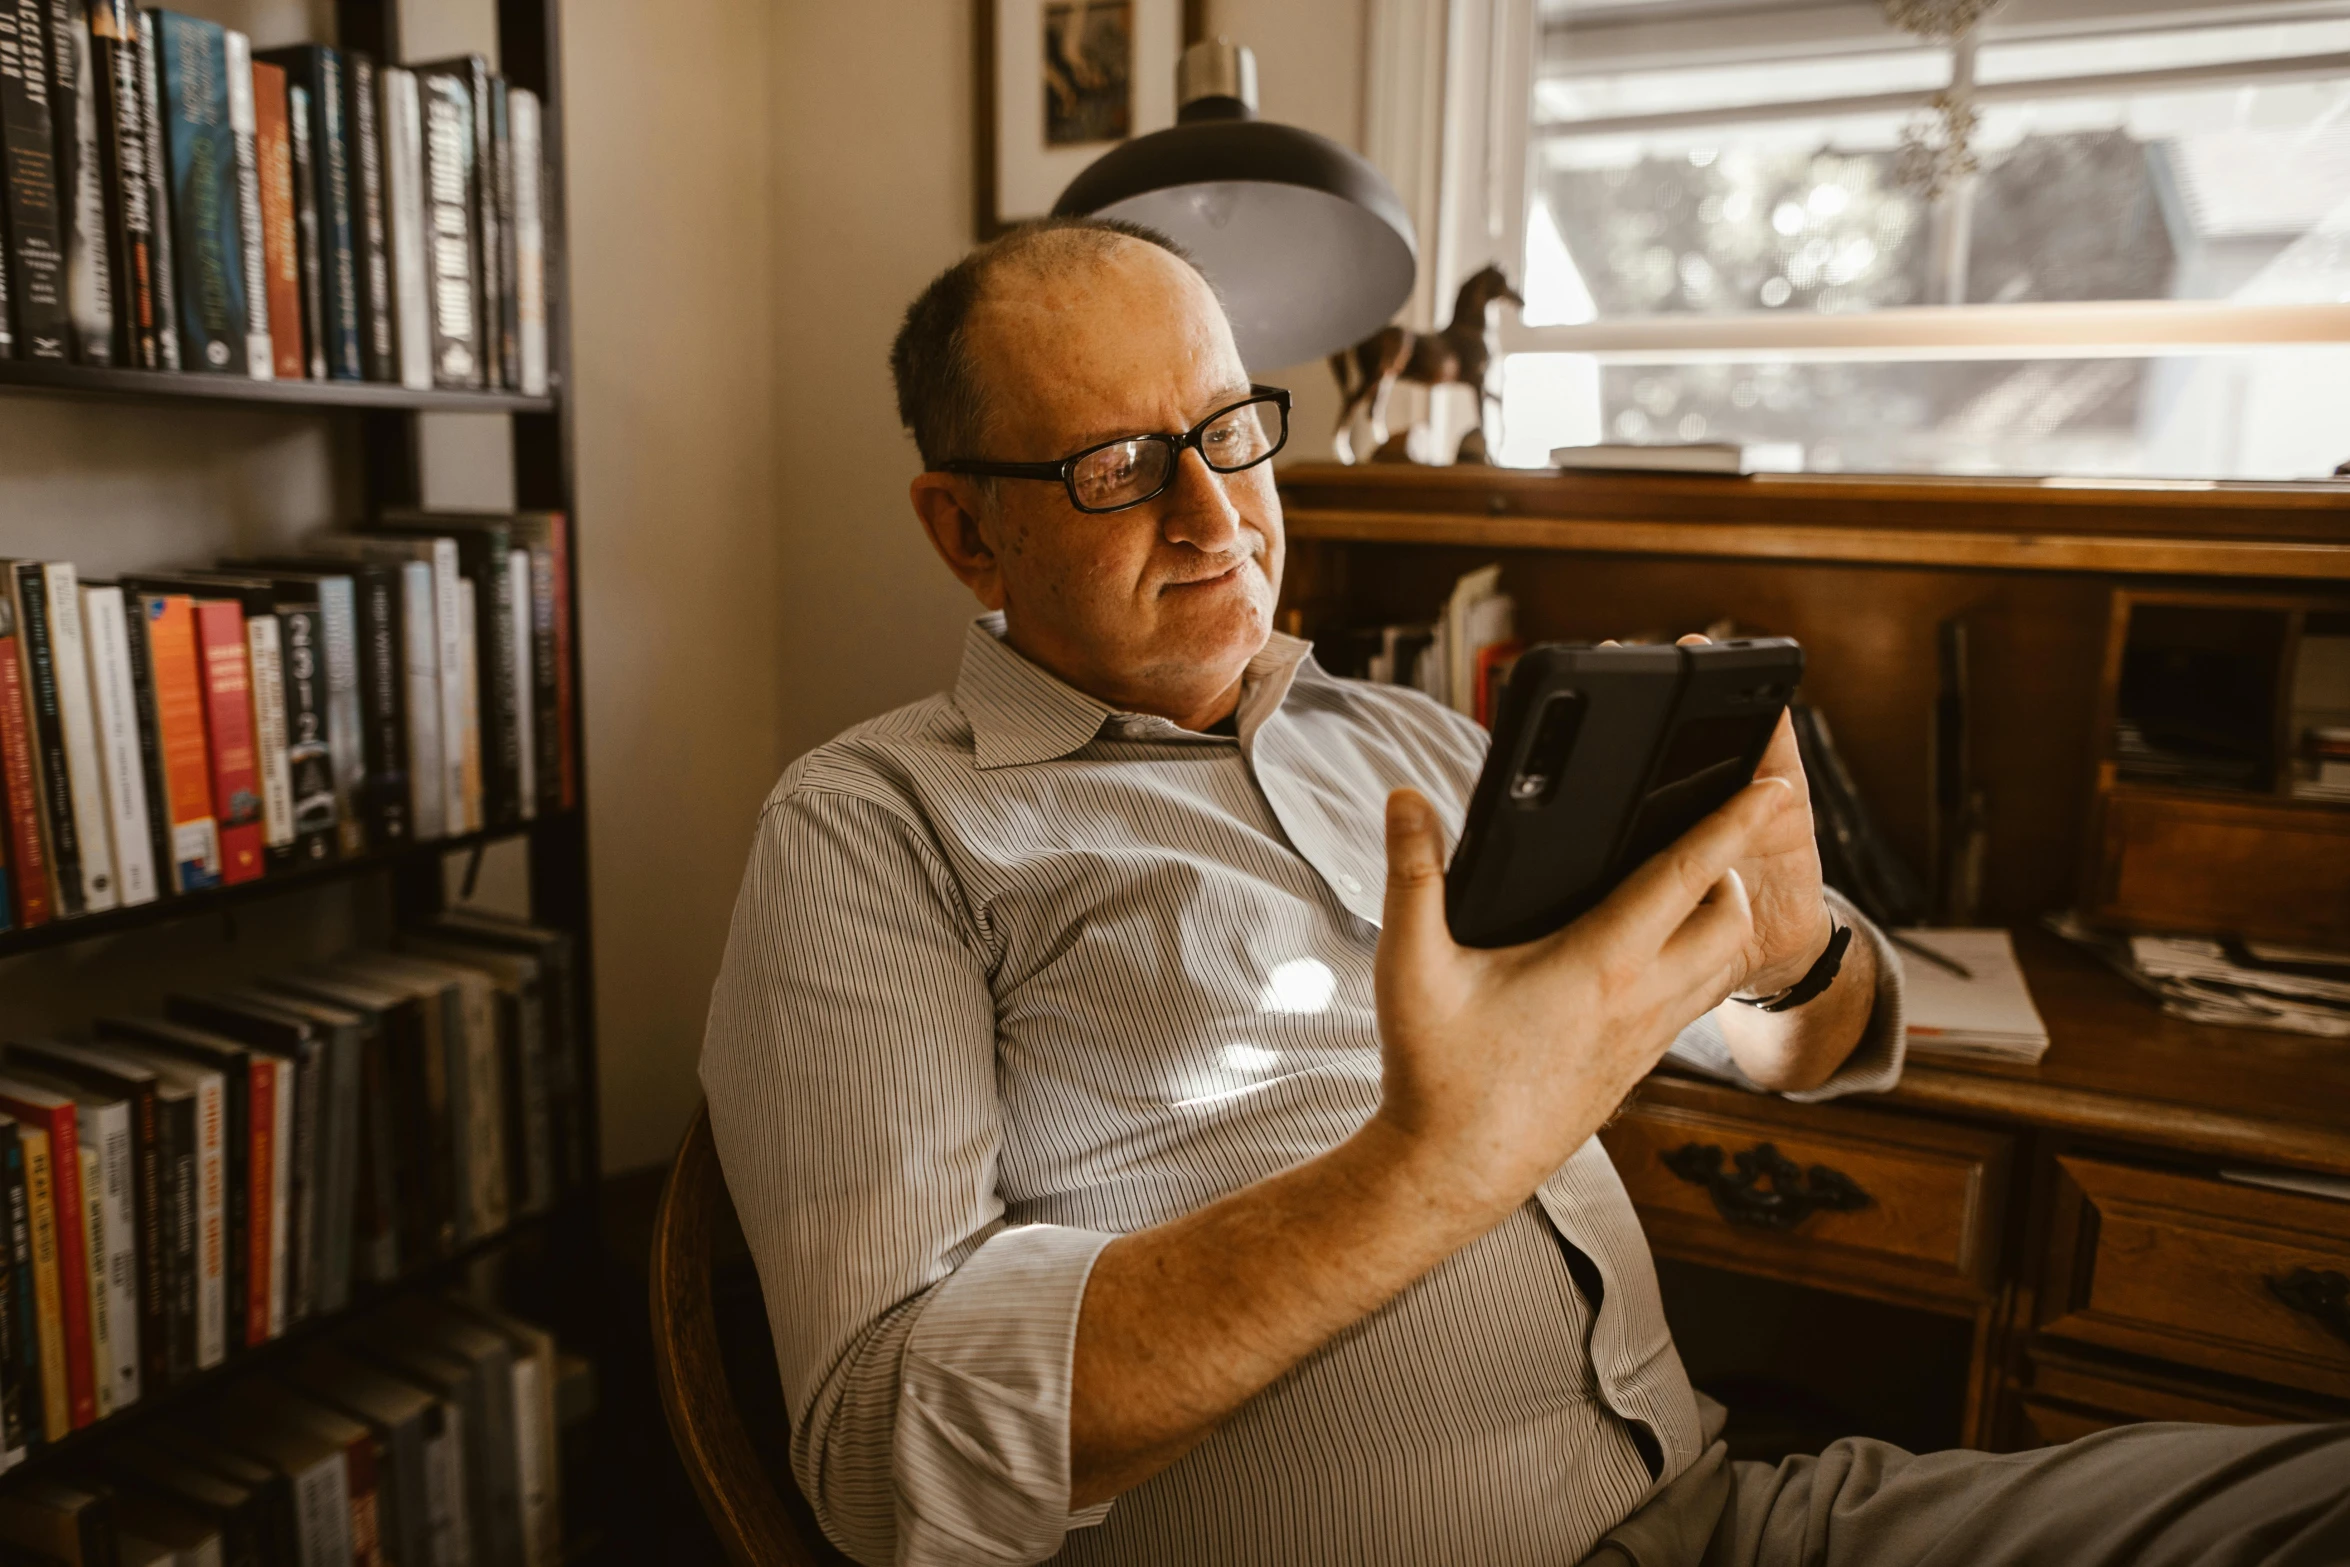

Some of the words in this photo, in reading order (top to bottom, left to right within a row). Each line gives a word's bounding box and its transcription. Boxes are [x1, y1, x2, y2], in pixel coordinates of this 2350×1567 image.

[0, 12, 18, 35] TO
[0, 40, 22, 79] WAR
[18, 0, 47, 106] ACCESSORY
[289, 613, 319, 743] 2312
